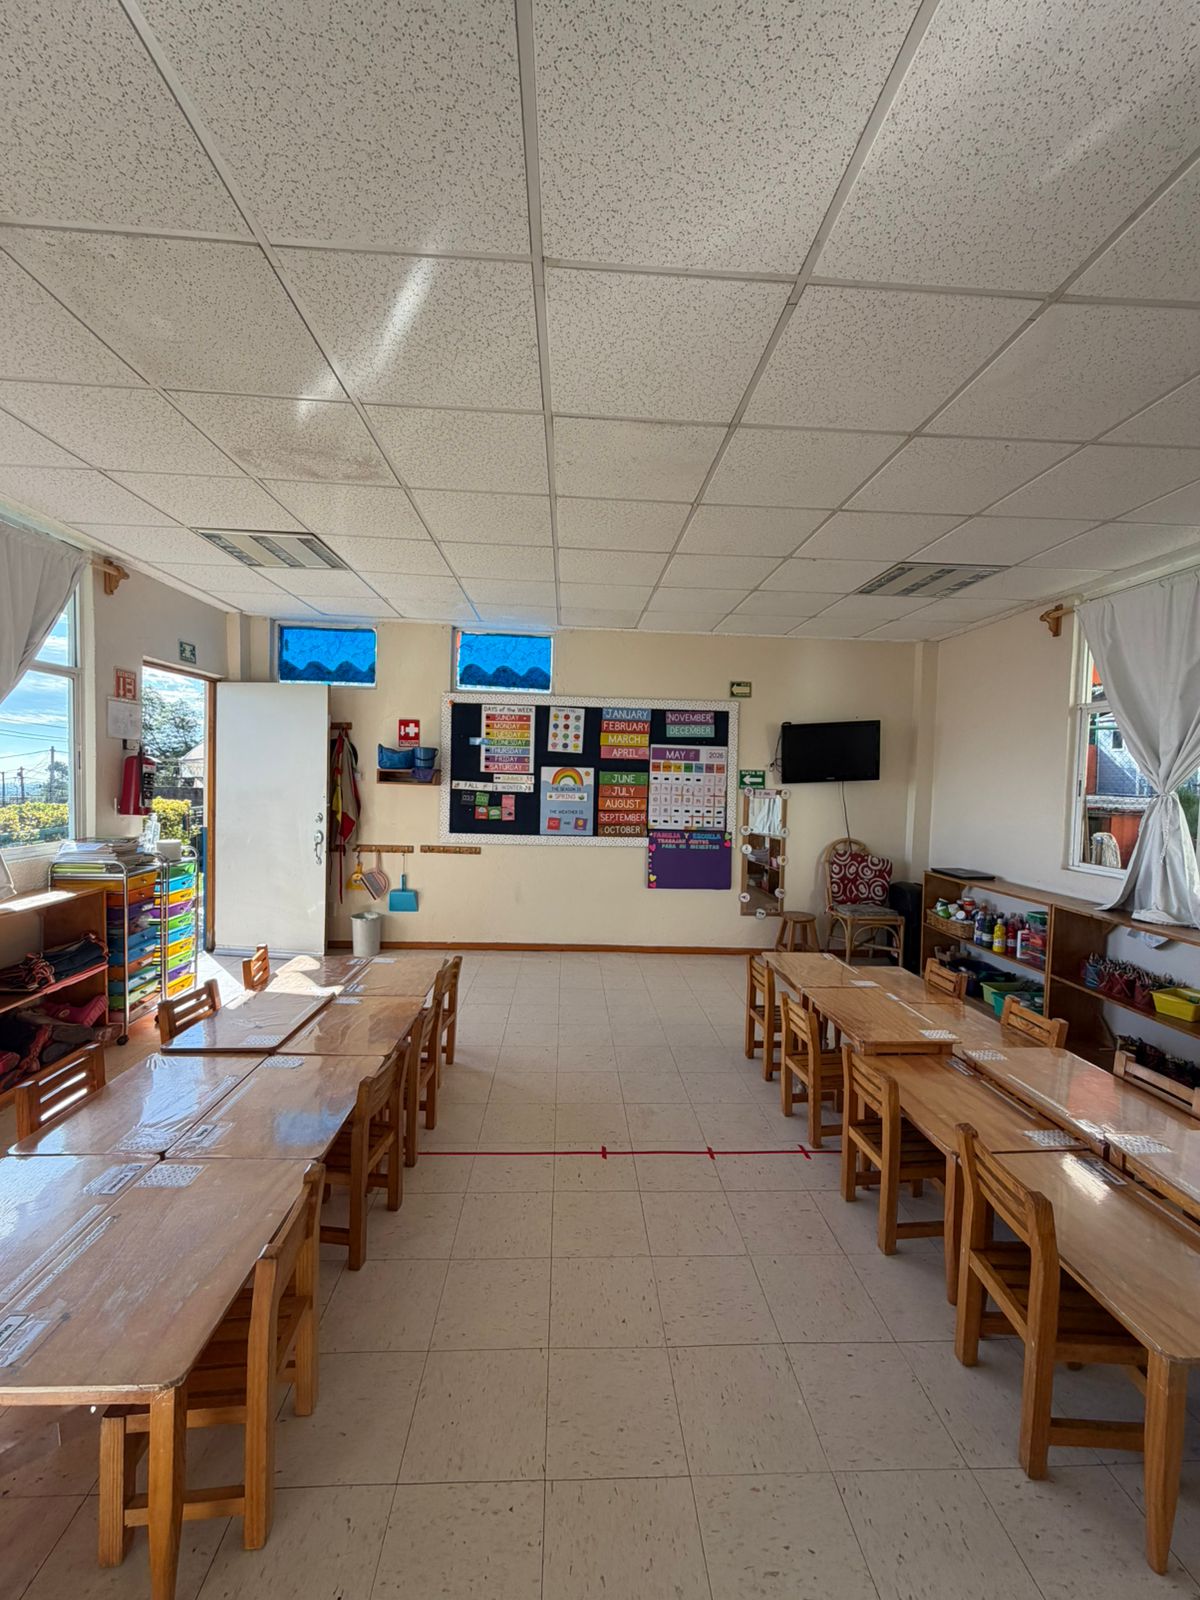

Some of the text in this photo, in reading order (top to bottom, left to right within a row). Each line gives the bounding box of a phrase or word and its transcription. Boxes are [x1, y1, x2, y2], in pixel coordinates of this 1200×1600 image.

[604, 709, 648, 719] JANUARY
[668, 713, 712, 722] NOVEMBER
[603, 721, 649, 731] FEBRUARY
[669, 726, 711, 735] DECEMBER
[608, 736, 641, 744] MARCH
[612, 749, 639, 758] APRIL
[665, 750, 686, 759] MAY
[611, 774, 636, 783] JUNE
[611, 786, 636, 796] JULY
[605, 799, 641, 809] AUGUST
[600, 813, 646, 822] SEPTEMBER
[604, 826, 641, 834] OCTOBER
